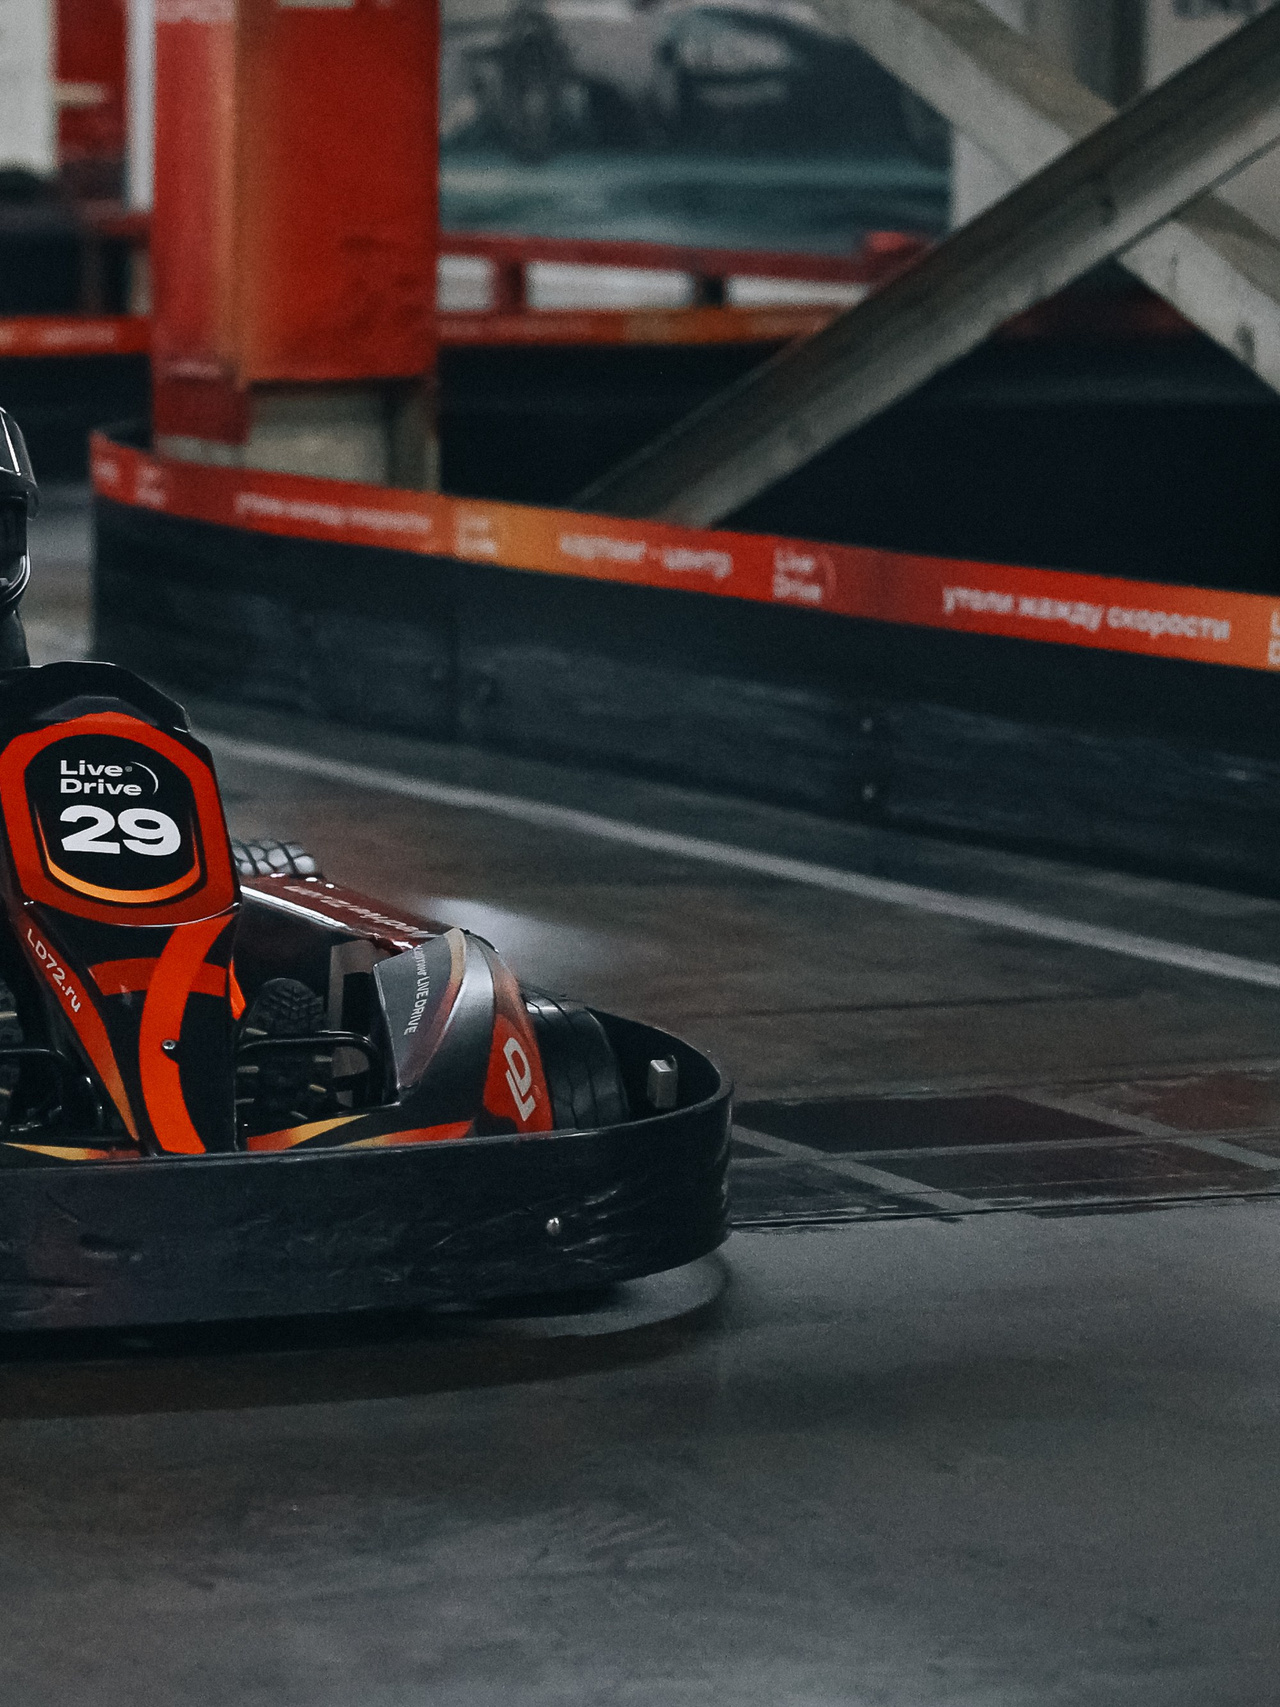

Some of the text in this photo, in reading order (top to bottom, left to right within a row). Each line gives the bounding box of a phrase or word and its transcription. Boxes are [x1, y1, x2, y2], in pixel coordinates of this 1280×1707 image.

[943, 586, 1015, 615] утоли
[1018, 595, 1104, 632] жажду
[1106, 606, 1231, 641] скорости
[60, 760, 123, 777] Live
[60, 778, 142, 796] Drive
[60, 804, 181, 856] 29
[25, 928, 82, 1013] LD72.ru
[403, 976, 430, 1036] LIVE DRIVE
